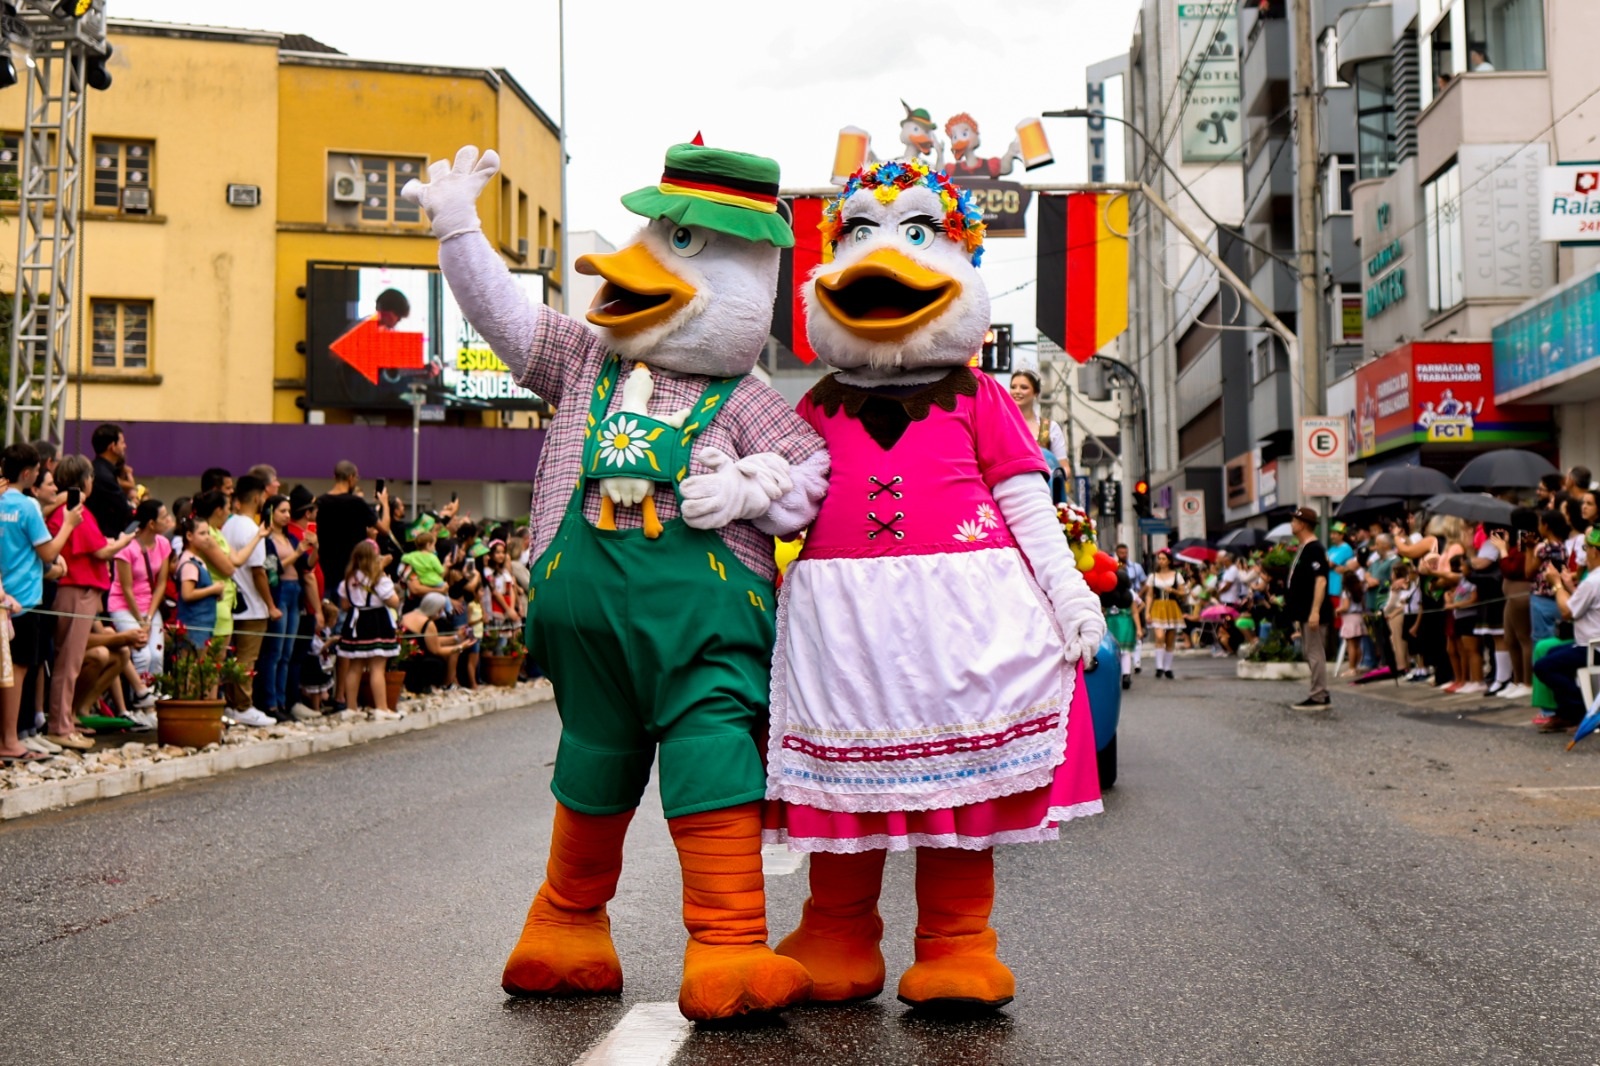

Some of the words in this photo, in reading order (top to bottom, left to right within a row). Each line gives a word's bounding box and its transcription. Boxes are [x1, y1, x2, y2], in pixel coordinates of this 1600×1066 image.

[1553, 196, 1600, 215] Raia
[1496, 156, 1521, 288] MASTER
[1525, 150, 1543, 290] ODONTOLOGIA
[1466, 363, 1481, 373] DO
[1417, 373, 1482, 382] TRABALHADOR
[1435, 424, 1465, 437] FCT
[1317, 435, 1330, 450] E
